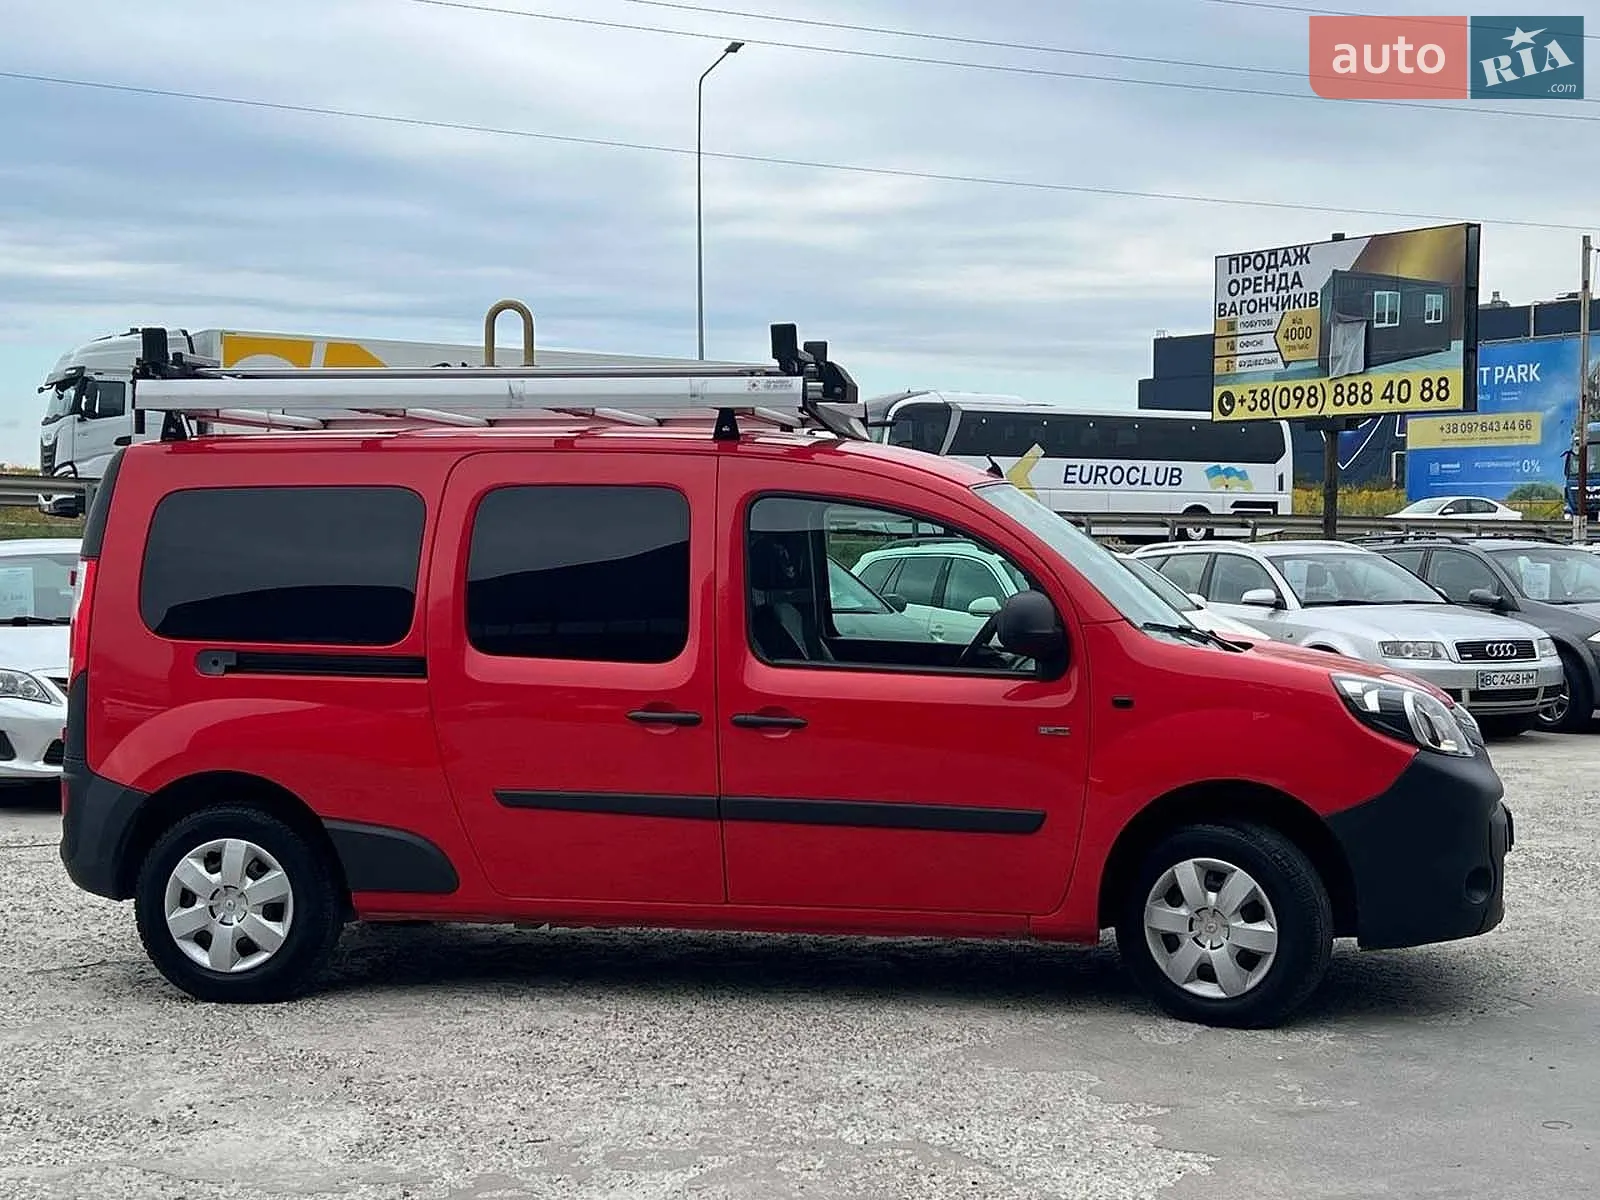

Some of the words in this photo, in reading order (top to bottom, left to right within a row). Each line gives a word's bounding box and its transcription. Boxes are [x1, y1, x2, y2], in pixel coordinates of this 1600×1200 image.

[1228, 246, 1310, 275] ПРОДАЖ
[1228, 271, 1304, 297] ОРЕНДА
[1217, 291, 1319, 318] ВАГОНЧИКІВ
[1283, 326, 1312, 341] 4000
[1494, 362, 1541, 385] PARK
[1238, 382, 1327, 416] +38(098)
[1332, 380, 1373, 407] 888
[1380, 378, 1412, 404] 40
[1419, 376, 1450, 402] 88
[1440, 422, 1458, 434] +38
[1460, 422, 1479, 433] 097
[1502, 420, 1516, 431] 44
[1518, 419, 1533, 431] 66
[1063, 464, 1183, 486] EUROCLUB
[1522, 459, 1541, 473] 0%
